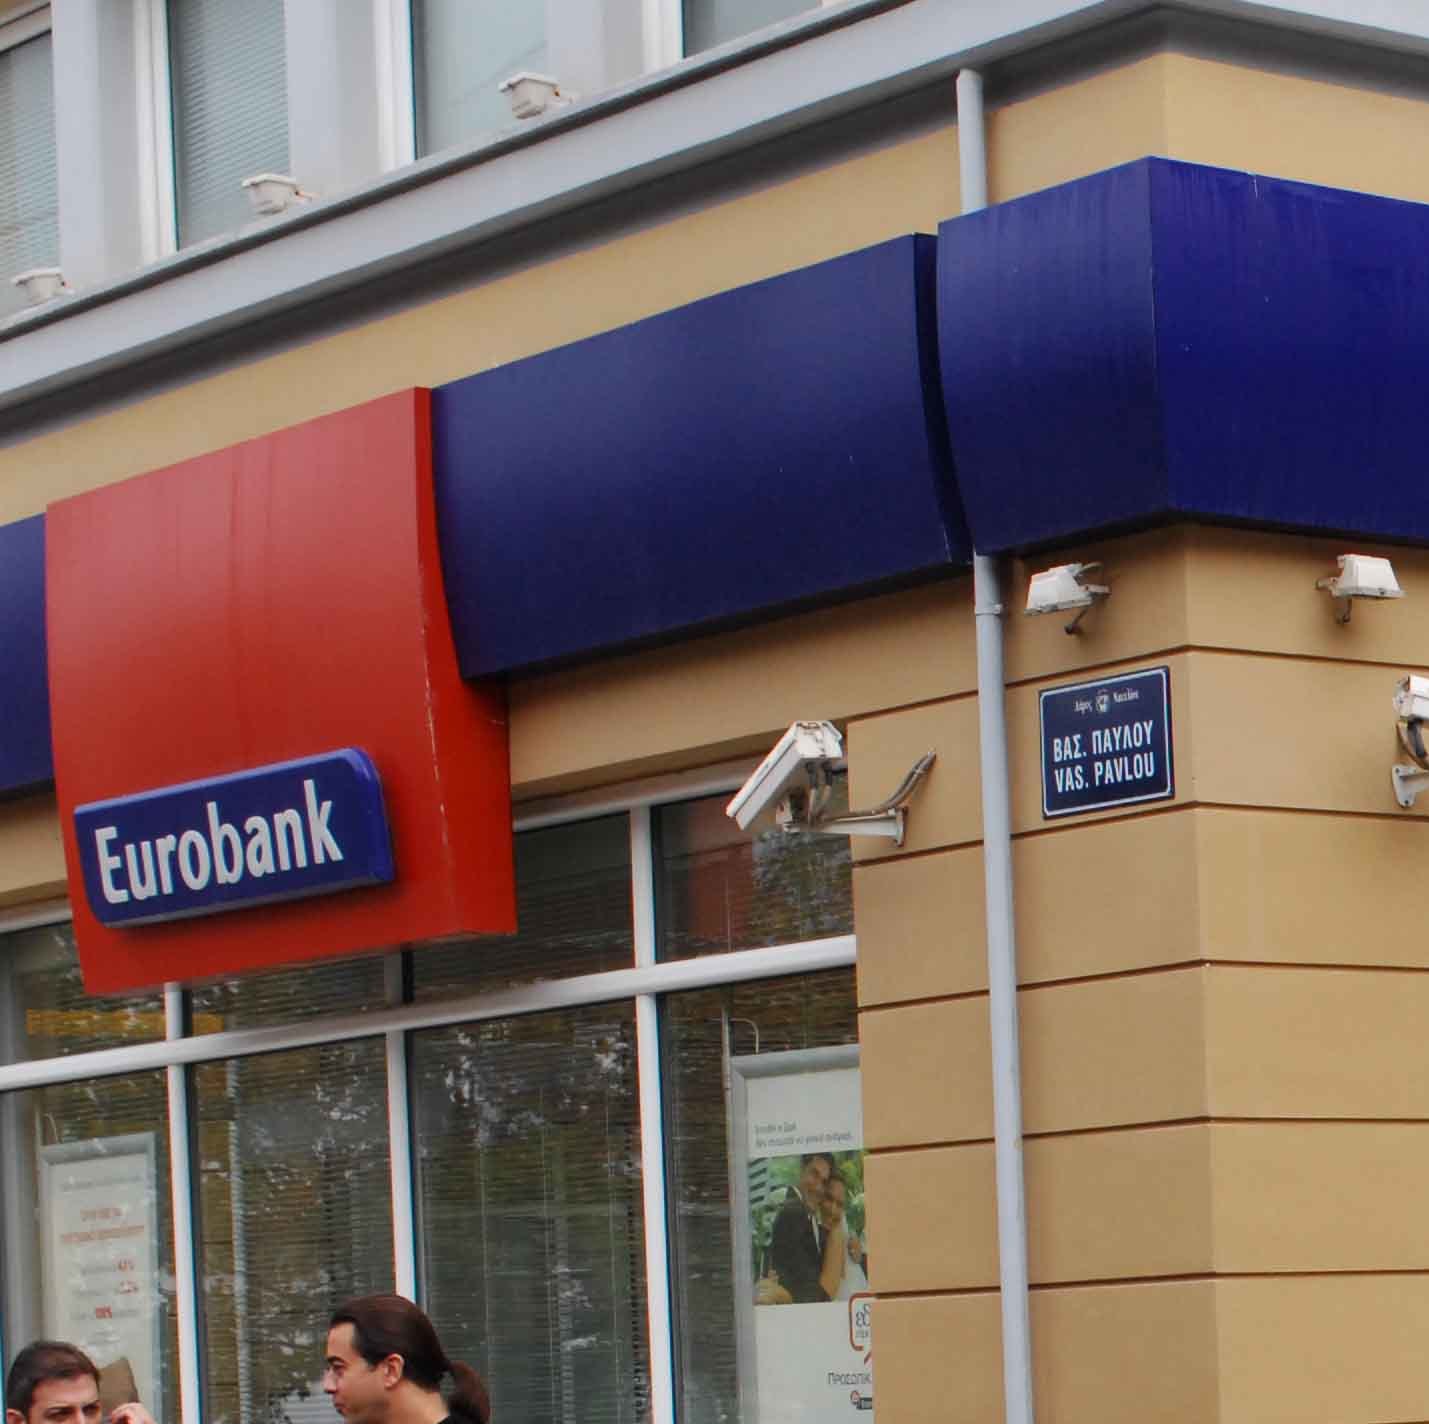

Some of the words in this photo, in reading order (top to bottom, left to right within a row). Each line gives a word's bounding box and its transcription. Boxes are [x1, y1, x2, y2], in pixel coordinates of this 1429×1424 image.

[1053, 734, 1087, 762] ΒΑΣ.
[1092, 720, 1153, 755] ΠΑΥΛΟΥ
[1054, 765, 1089, 793] VAS.
[1094, 752, 1155, 786] PAVLOU
[95, 779, 344, 904] Eurobank
